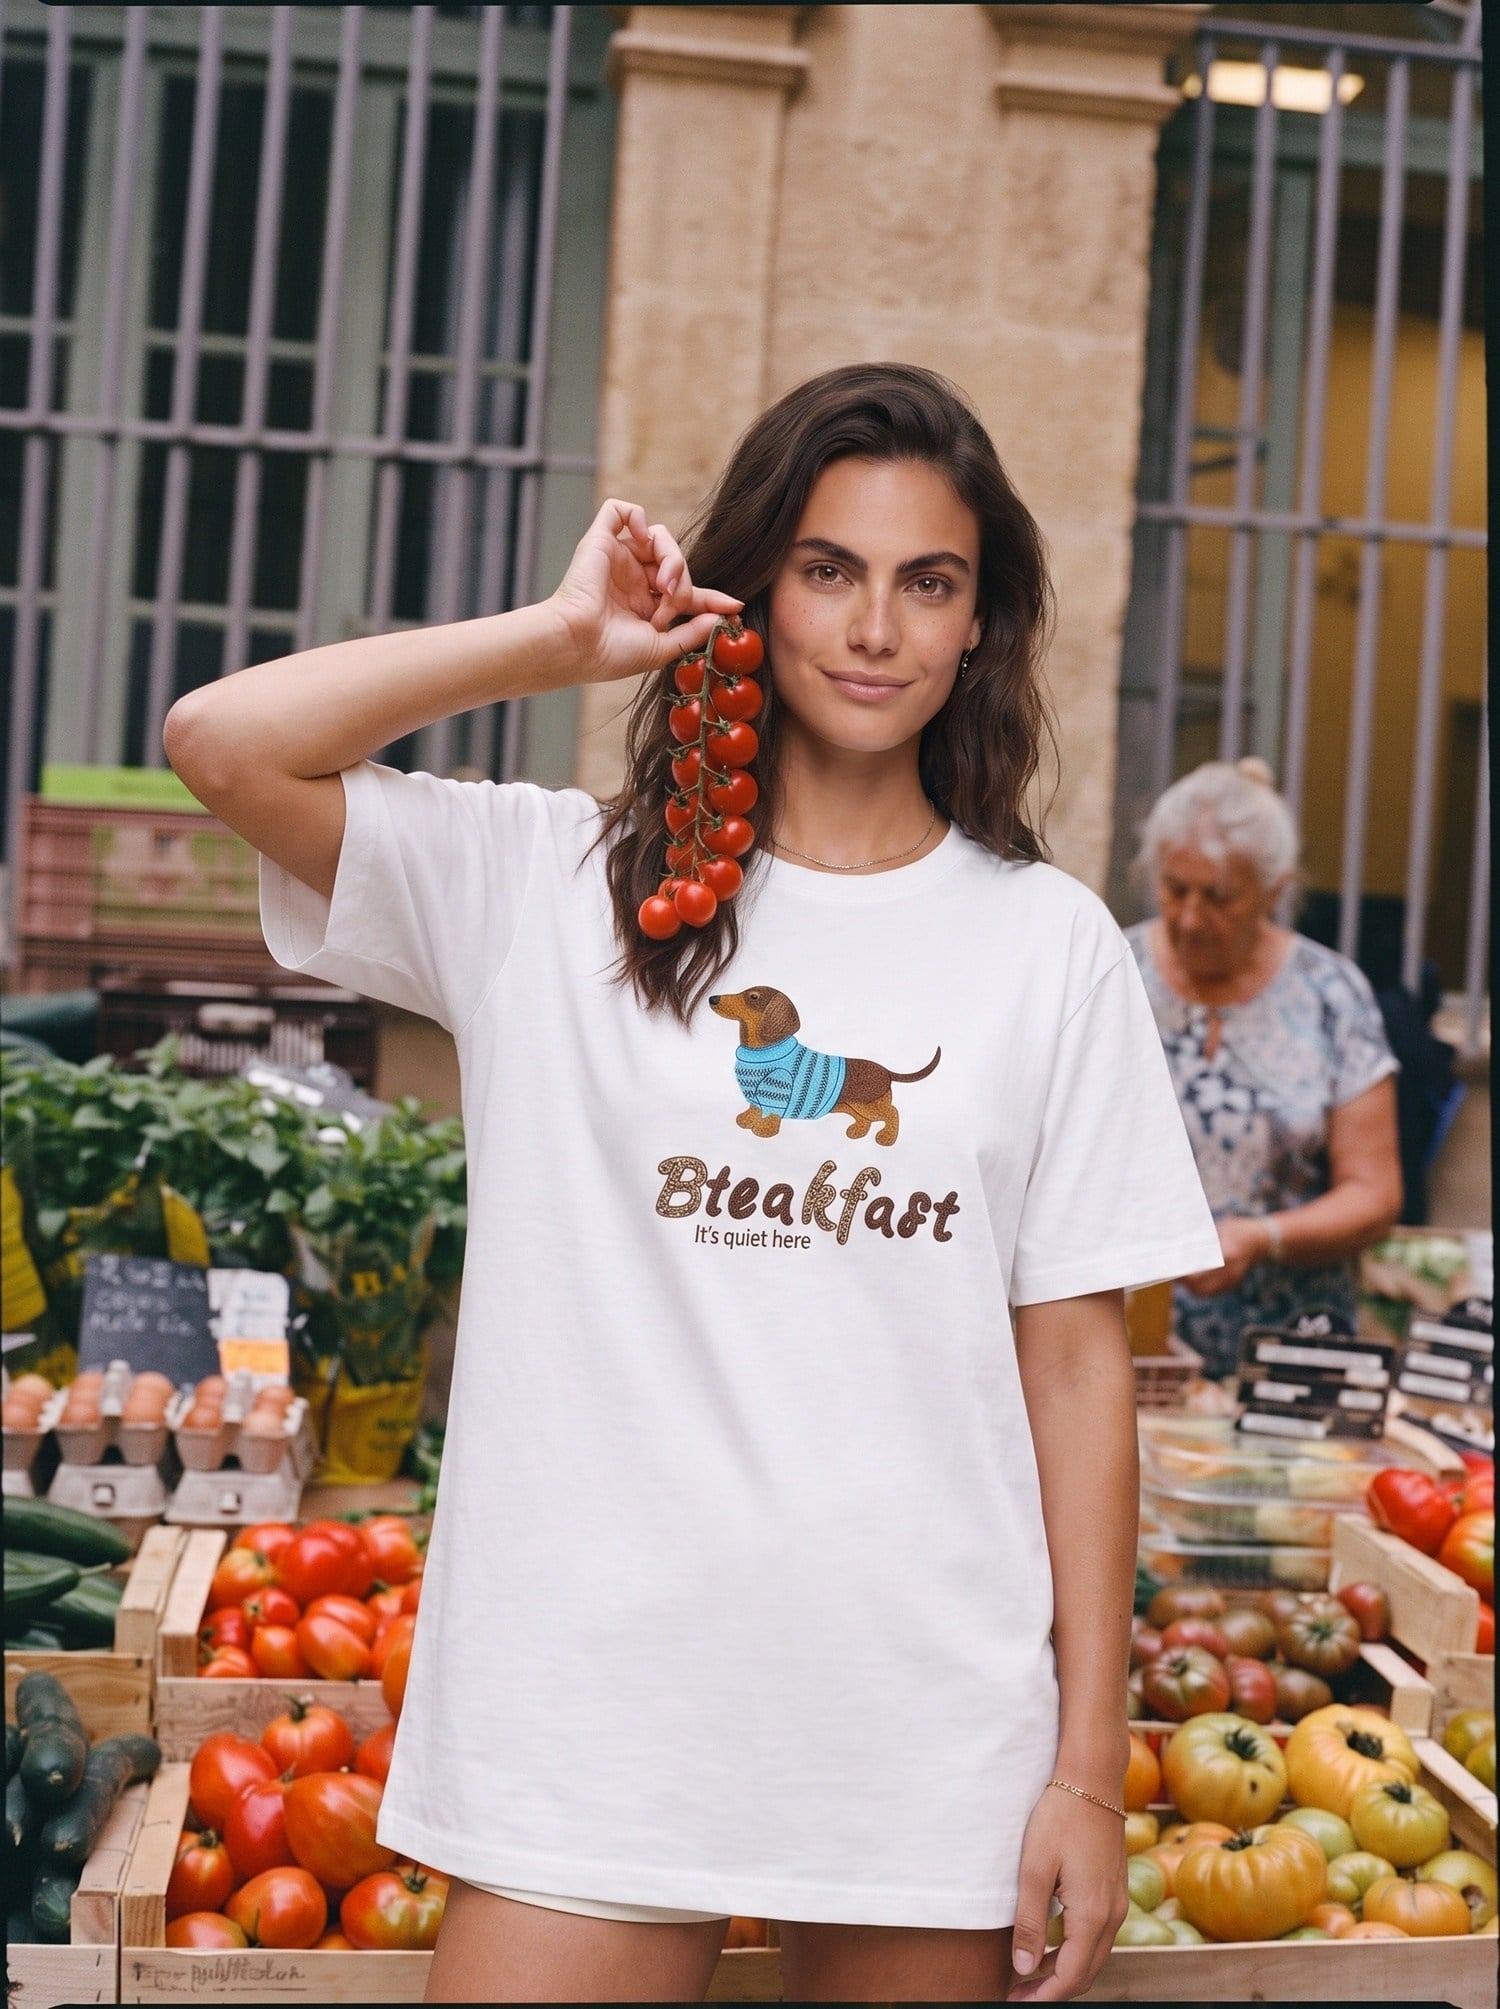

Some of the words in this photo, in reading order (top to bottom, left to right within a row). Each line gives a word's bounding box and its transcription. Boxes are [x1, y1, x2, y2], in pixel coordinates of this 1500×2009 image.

[694, 1224, 720, 1245] It's
[723, 1228, 768, 1250] quiet
[772, 1229, 812, 1250] here
